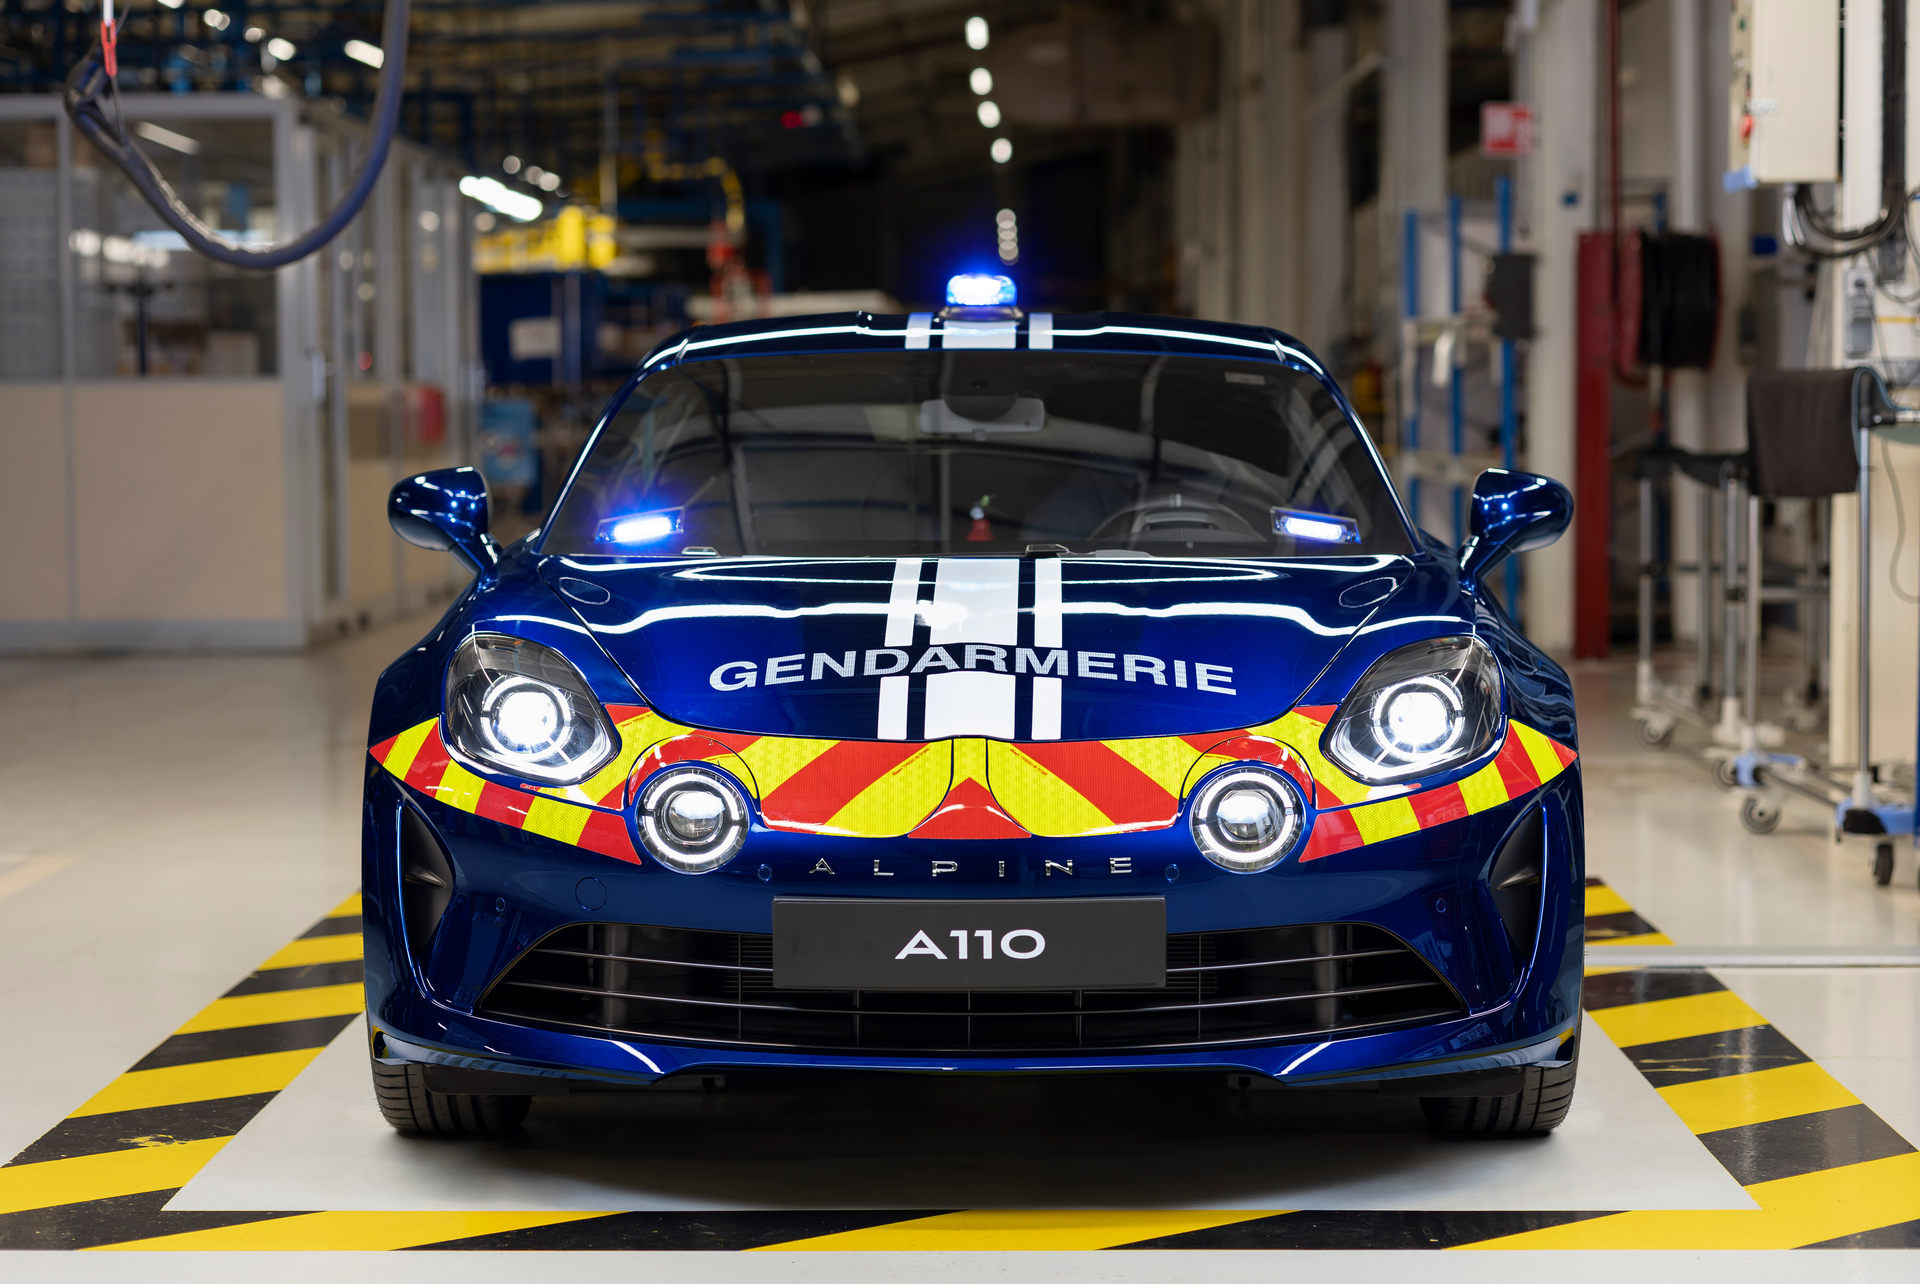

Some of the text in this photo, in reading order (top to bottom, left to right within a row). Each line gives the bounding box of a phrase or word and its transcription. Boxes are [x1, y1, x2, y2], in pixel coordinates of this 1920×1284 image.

[709, 644, 1237, 695] GENDARMERIE
[809, 857, 1132, 877] ALPINE
[894, 929, 1046, 960] A110
